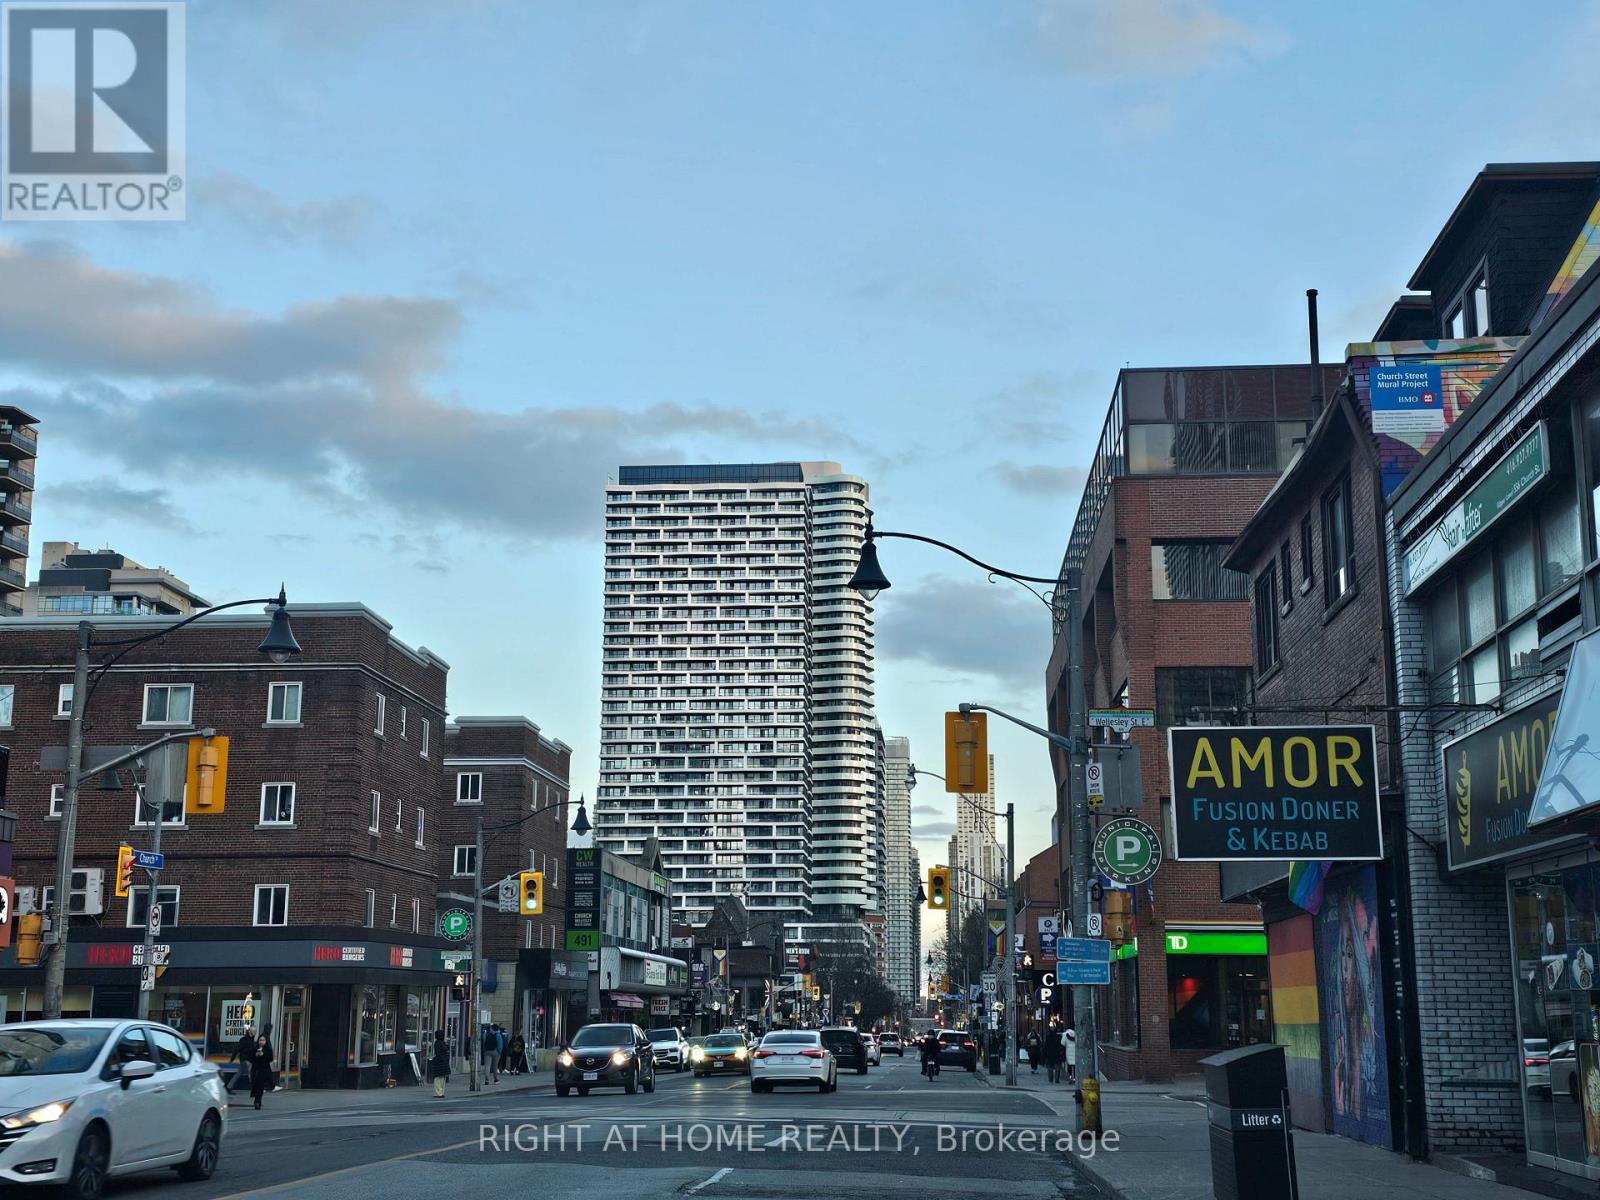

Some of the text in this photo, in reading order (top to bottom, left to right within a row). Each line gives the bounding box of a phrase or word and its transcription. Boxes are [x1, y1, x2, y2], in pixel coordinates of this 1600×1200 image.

[1377, 372, 1402, 380] Church
[1401, 380, 1428, 389] Project
[1096, 717, 1129, 728] Wellesley
[1186, 735, 1364, 789] AMOR
[1097, 821, 1158, 849] MUNICIPAL
[1227, 827, 1246, 850] &
[1117, 836, 1141, 861] P
[1098, 857, 1158, 882] PARKING
[451, 917, 464, 930] P
[574, 935, 592, 946] 491
[1168, 935, 1187, 949] TD
[984, 982, 995, 991] 30
[1242, 1113, 1269, 1126] Litter
